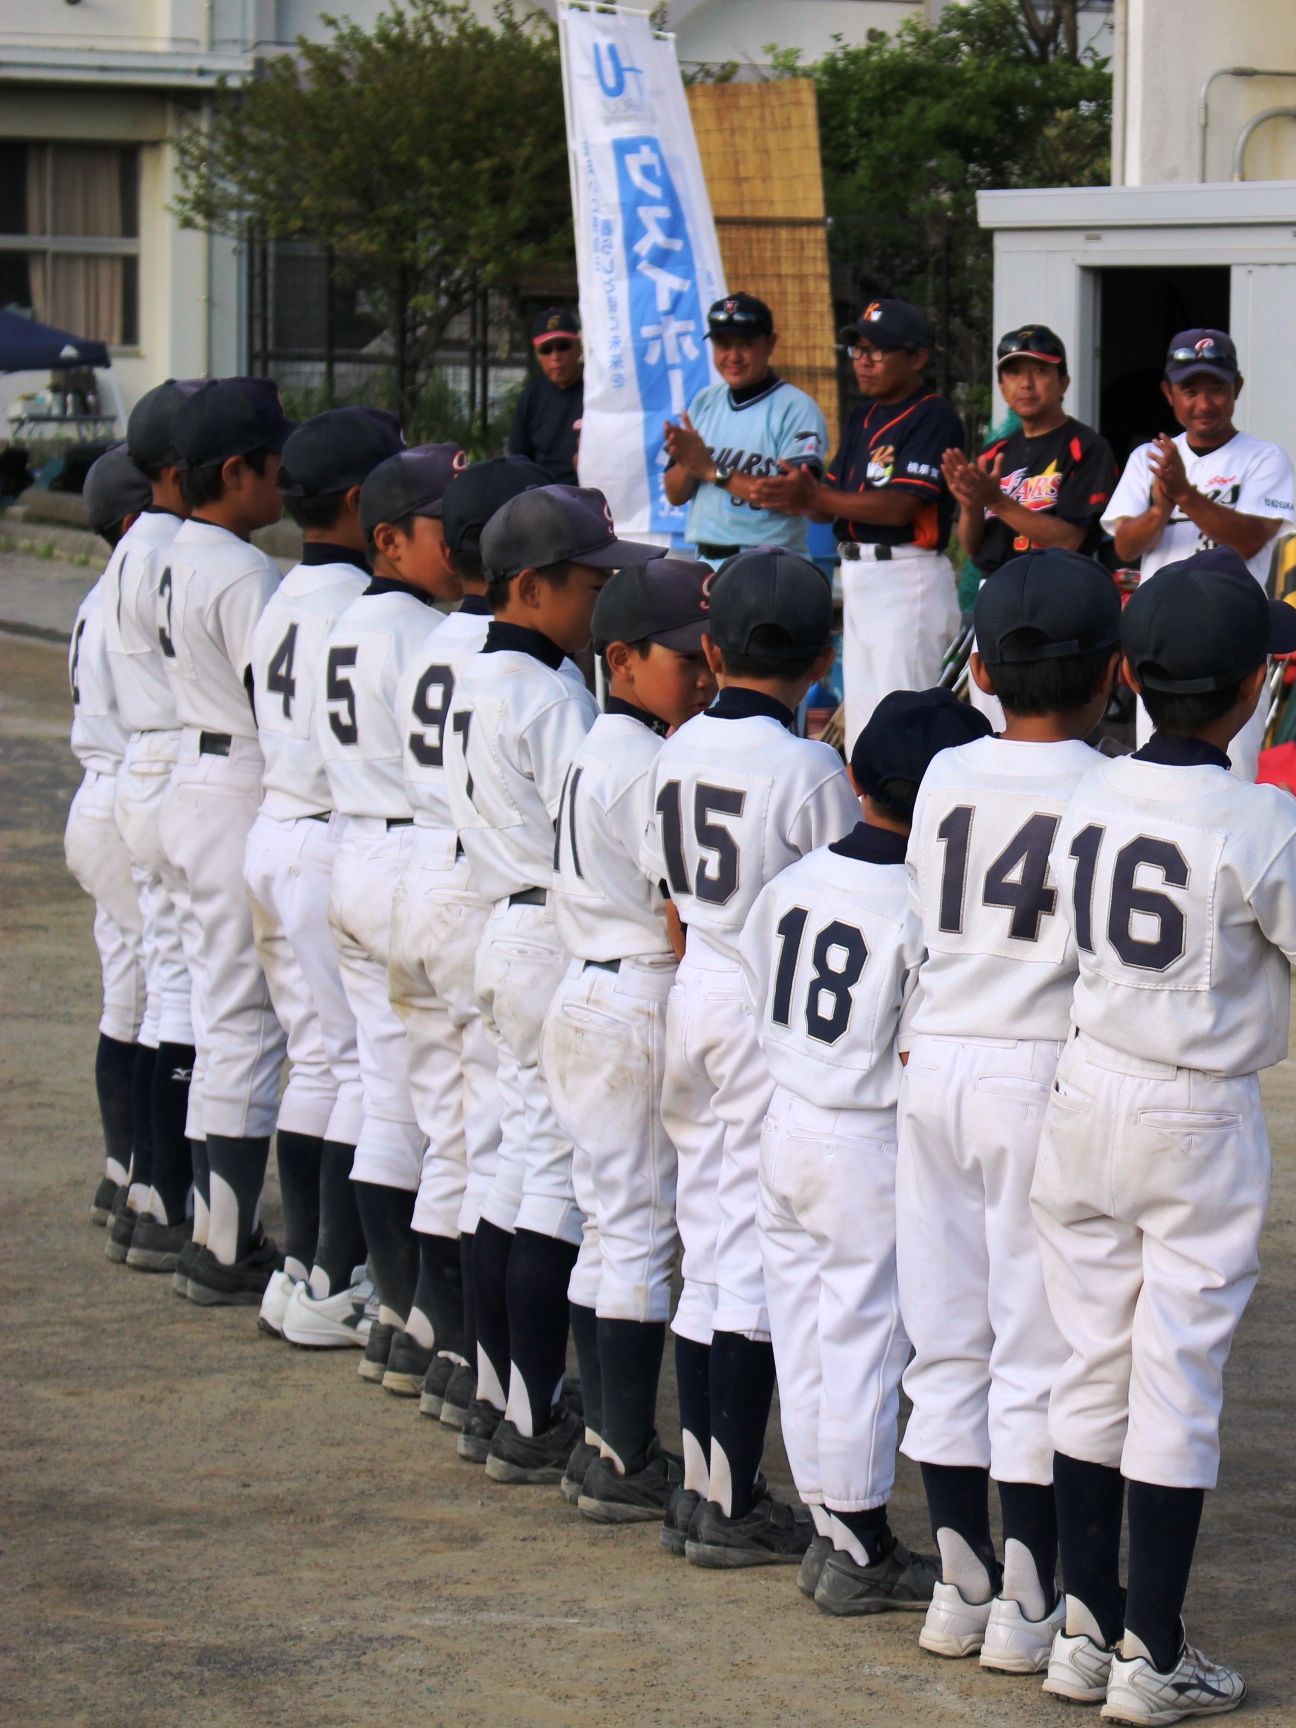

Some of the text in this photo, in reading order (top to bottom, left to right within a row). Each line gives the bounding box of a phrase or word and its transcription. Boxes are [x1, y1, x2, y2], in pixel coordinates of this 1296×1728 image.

[267, 620, 300, 722] 4
[326, 644, 359, 747] 5
[408, 663, 457, 768] 9
[656, 779, 747, 906] 15
[937, 804, 1062, 942] 14
[1068, 822, 1192, 973] 16
[771, 904, 871, 1046] 18
